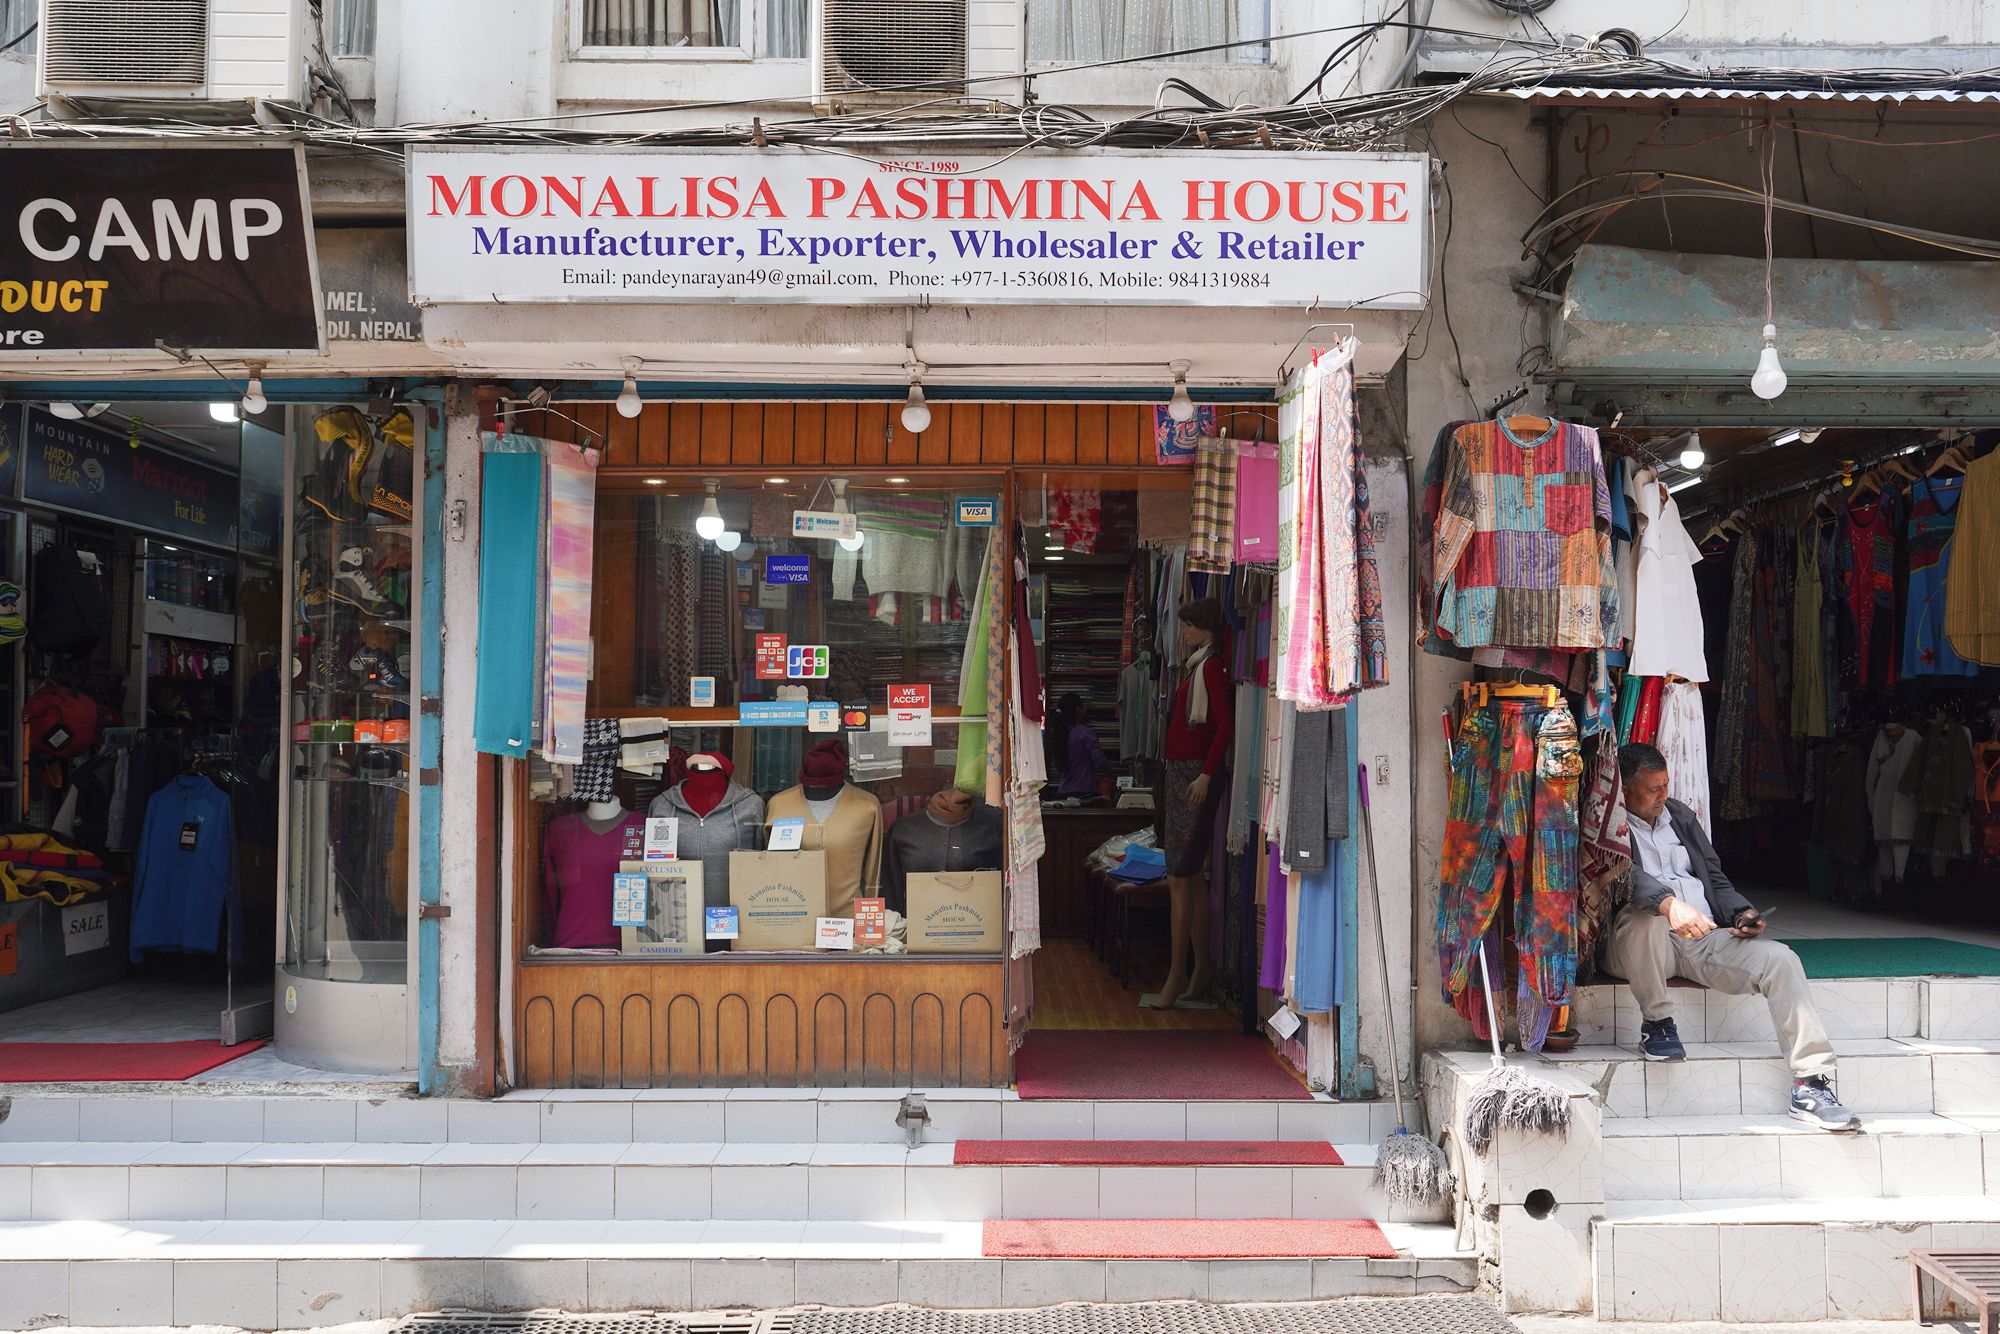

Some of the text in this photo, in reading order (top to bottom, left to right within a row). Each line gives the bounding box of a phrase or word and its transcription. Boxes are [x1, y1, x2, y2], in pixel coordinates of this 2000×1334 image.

[879, 161, 960, 173] SINCE-1989
[427, 175, 1409, 223] MONALISA PASHMINA HOUSE
[18, 197, 283, 262] CAMP
[472, 226, 1366, 265] Manufacturer, Exporter, Wholesaler & Retailer
[562, 268, 1271, 290] Email: pandeynarayan49@gmail.com, Phone: +977-1-5360816, Mobile: 9841319884
[0, 329, 45, 346] re
[34, 422, 111, 456] MOUNTAIN
[43, 444, 75, 467] HARD
[47, 463, 80, 488] WEAR
[130, 453, 208, 503] Marmot
[174, 498, 190, 521] For
[965, 507, 988, 516] VISA
[815, 517, 841, 527] Welcome
[771, 563, 809, 572] welcome
[788, 573, 809, 582] VISA
[892, 696, 926, 704] ACCEPT
[902, 687, 916, 696] WE
[639, 865, 684, 874] EXCLUSIVE
[70, 913, 105, 935] SALE
[639, 946, 684, 954] CASHMERE
